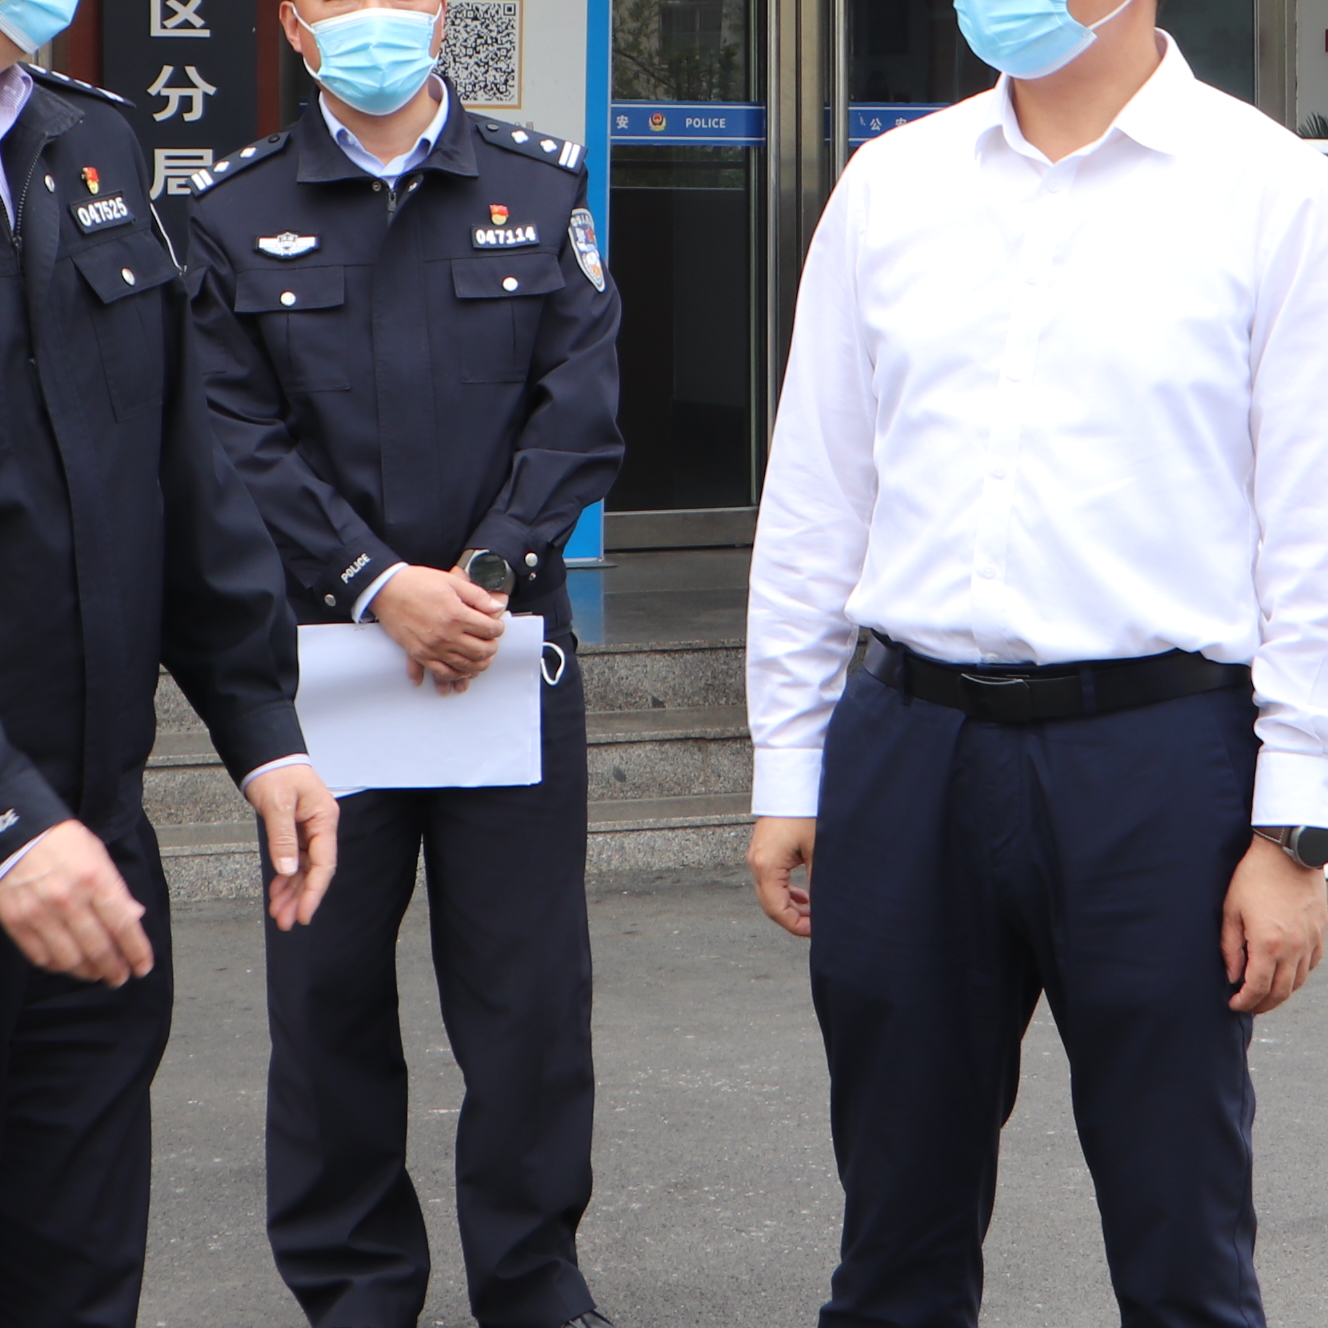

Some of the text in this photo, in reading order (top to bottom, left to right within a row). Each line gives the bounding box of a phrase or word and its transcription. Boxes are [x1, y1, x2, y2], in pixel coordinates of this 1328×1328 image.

[616, 115, 727, 129] 安 POLICE
[77, 196, 129, 227] 047525
[475, 225, 536, 245] 047114
[340, 552, 371, 584] POLICE
